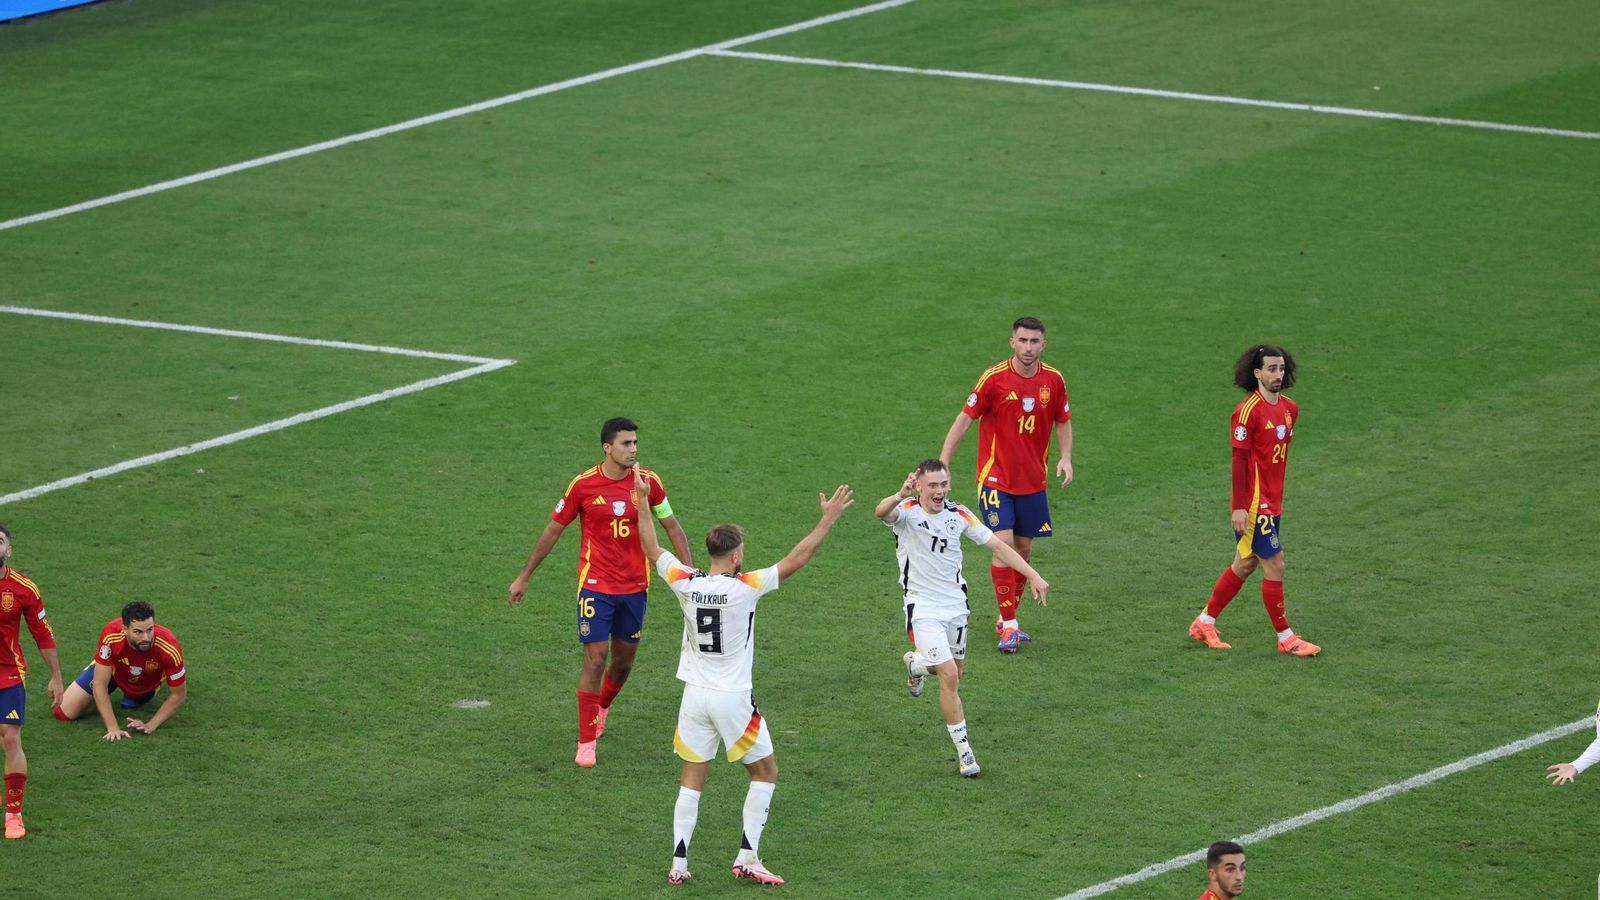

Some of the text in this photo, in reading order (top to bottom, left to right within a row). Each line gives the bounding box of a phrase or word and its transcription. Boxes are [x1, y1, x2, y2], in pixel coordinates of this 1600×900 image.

[1017, 415, 1036, 434] 14
[1272, 443, 1287, 464] 24
[980, 489, 1000, 511] 14
[610, 518, 631, 539] 16
[578, 597, 596, 619] 16
[696, 607, 724, 655] 9
